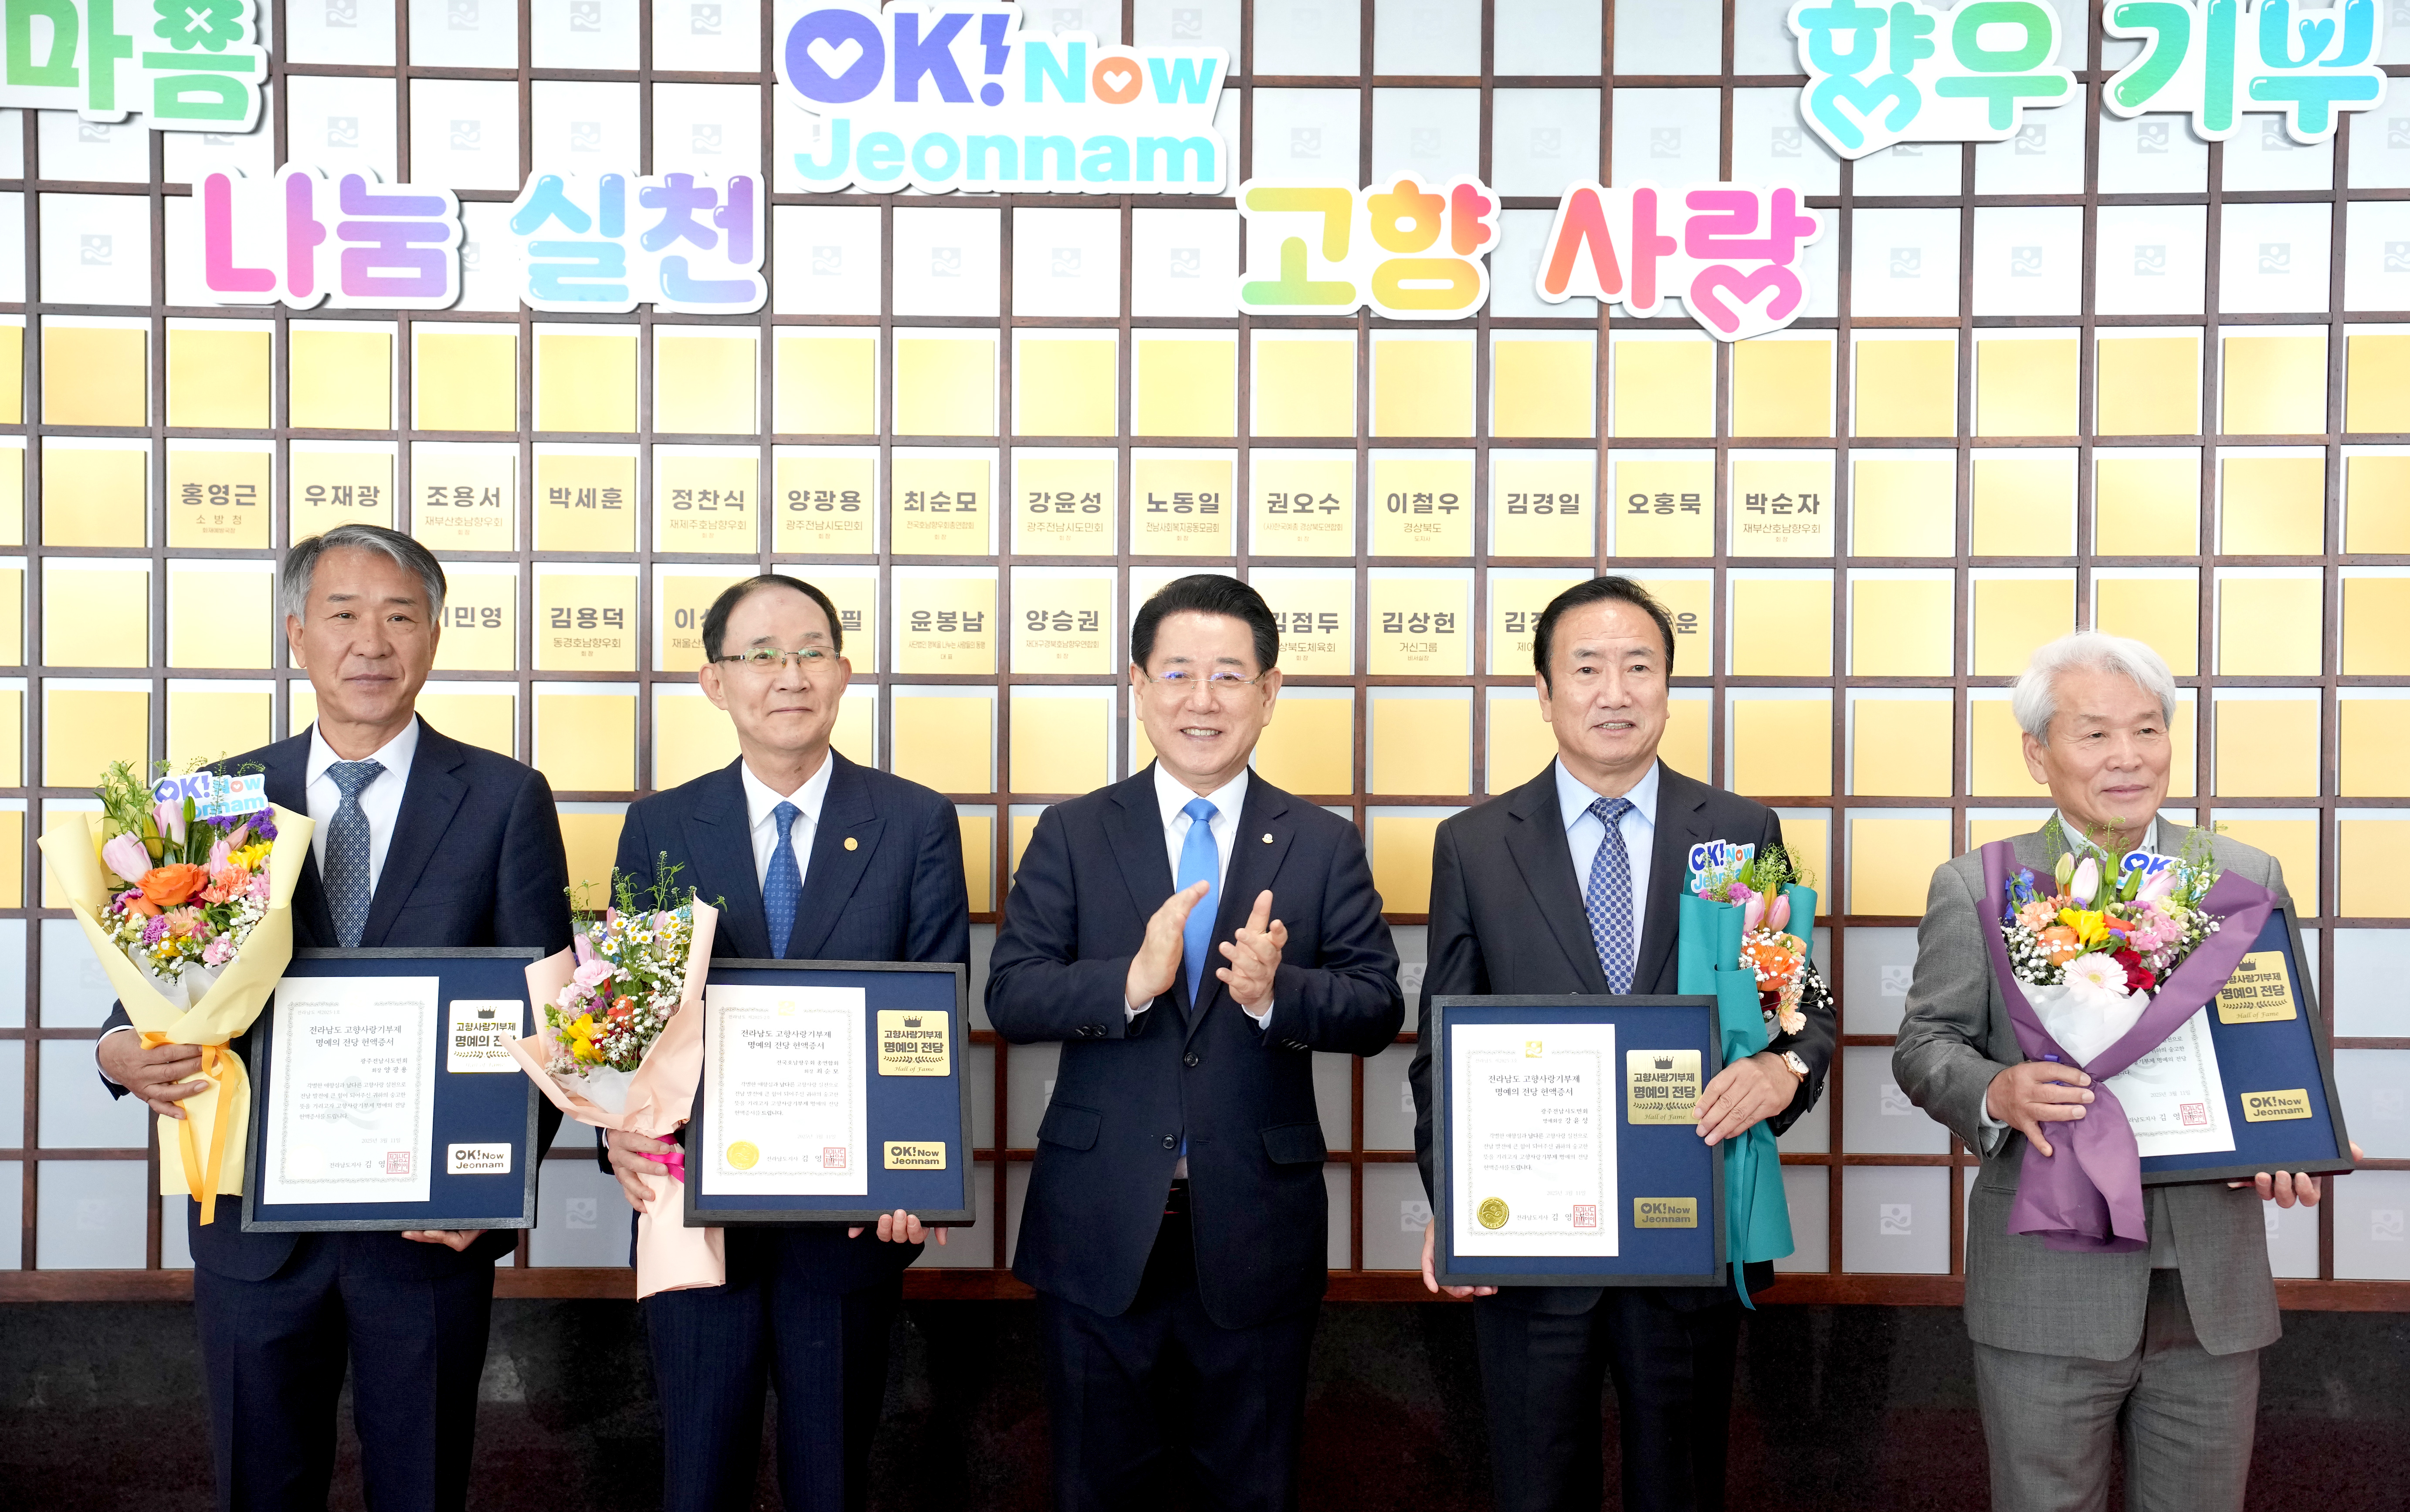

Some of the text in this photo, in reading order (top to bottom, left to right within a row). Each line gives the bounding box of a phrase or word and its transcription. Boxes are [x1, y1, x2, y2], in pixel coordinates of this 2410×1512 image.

[785, 9, 1217, 106] OK! Now
[1798, 0, 2379, 149] 향우 기부
[794, 118, 1215, 181] Jeonnam
[204, 172, 757, 303] 나눔 실천
[1241, 179, 1817, 333] 고향 사랑
[181, 483, 257, 506] 홍영근
[305, 485, 380, 507] 우재광
[427, 486, 500, 508] 조용서
[549, 487, 623, 509] 박세훈
[672, 489, 744, 511] 정찬식
[788, 490, 861, 512] 양광용
[904, 490, 977, 512] 최순모
[1029, 492, 1101, 514] 강윤성
[1147, 492, 1219, 514] 노동일
[1267, 493, 1340, 515] 권오수
[1387, 492, 1459, 514] 이철우
[1507, 493, 1579, 514] 김경일
[1627, 493, 1701, 515] 오홍묵
[1746, 493, 1820, 514] 박순자
[425, 516, 502, 527] 재부산호남향우회
[670, 519, 746, 530] 재제주호남향우회
[786, 520, 862, 531] 광주전남시도민회
[1027, 522, 1103, 532] 광주전남시도민회
[1146, 522, 1219, 533] 전남사회복지공동모금회
[1300, 523, 1343, 531] 경상북도연합회
[1403, 523, 1442, 533] 경상북도
[1743, 523, 1820, 534] 재부산호남향우회
[551, 607, 623, 629] 김용덕
[911, 610, 984, 632] 윤봉남
[1026, 610, 1098, 632] 양승권
[1383, 612, 1454, 634] 김상헌
[553, 637, 621, 648] 동경호남향우회
[1026, 640, 1099, 649] 재대구경북호남향우연합회
[1400, 642, 1437, 653] 거신그룹
[155, 775, 210, 804] OK!
[2220, 984, 2285, 1000] 명예의 전당
[309, 1025, 401, 1035] 전라남도 고향사랑기부제
[456, 1022, 515, 1032] 고향사랑기부제
[741, 1029, 831, 1038] 전라남도 고향사랑기부제
[885, 1030, 942, 1039] 고향사랑기부제
[315, 1037, 393, 1047] 명예의 전당 헌액증서
[455, 1035, 490, 1047] 명예의
[748, 1041, 824, 1050] 명예의 전당 헌액증서
[885, 1042, 943, 1054] 명예의 전당
[1488, 1074, 1580, 1084] 전라남도 고향사랑기부제
[1634, 1073, 1694, 1082] 고향사랑기부제
[1495, 1087, 1573, 1096] 명예의 전당 헌액증서
[1634, 1086, 1695, 1099] 명예의 전당
[2250, 1096, 2301, 1108] OK! Now
[2253, 1106, 2304, 1116] Jeonnam
[455, 1150, 480, 1160] OK!
[891, 1147, 915, 1157] OK!
[456, 1160, 503, 1169] Jeonnam
[1641, 1203, 1666, 1214] OK!
